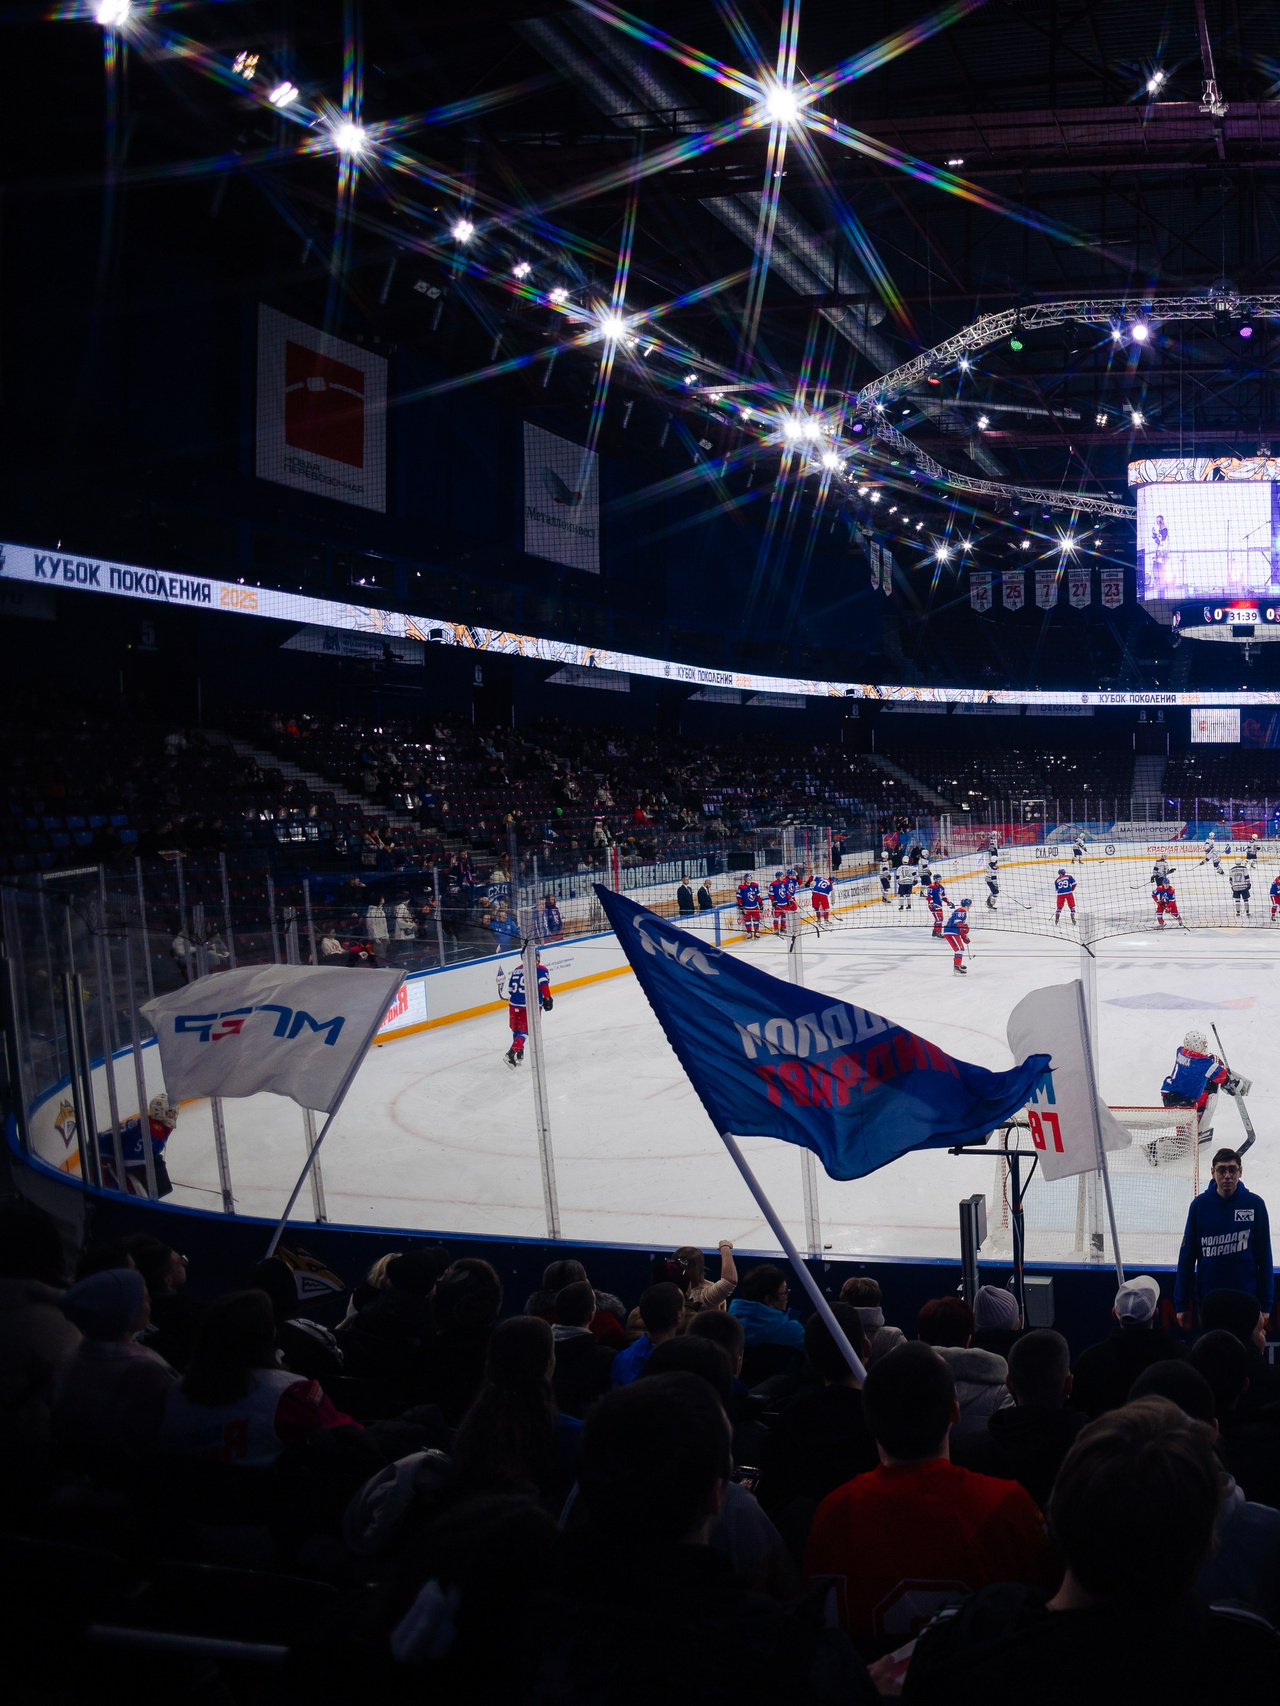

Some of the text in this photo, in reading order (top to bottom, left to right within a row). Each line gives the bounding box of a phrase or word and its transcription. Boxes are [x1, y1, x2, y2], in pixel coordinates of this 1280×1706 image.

[284, 454, 320, 471] НОВАЯ
[34, 553, 258, 611] КУБОК ПОКОЛЕНИЯ 2025
[1105, 583, 1120, 597] 23
[1214, 609, 1222, 620] 0
[1230, 612, 1257, 621] 31:39
[1266, 609, 1274, 620] 0
[677, 666, 696, 680] КУБОК
[698, 669, 733, 685] ПОКОЛЕНИЯ
[1099, 694, 1126, 703] КУБОК
[1130, 694, 1177, 703] ПОКОЛЕНИЯ
